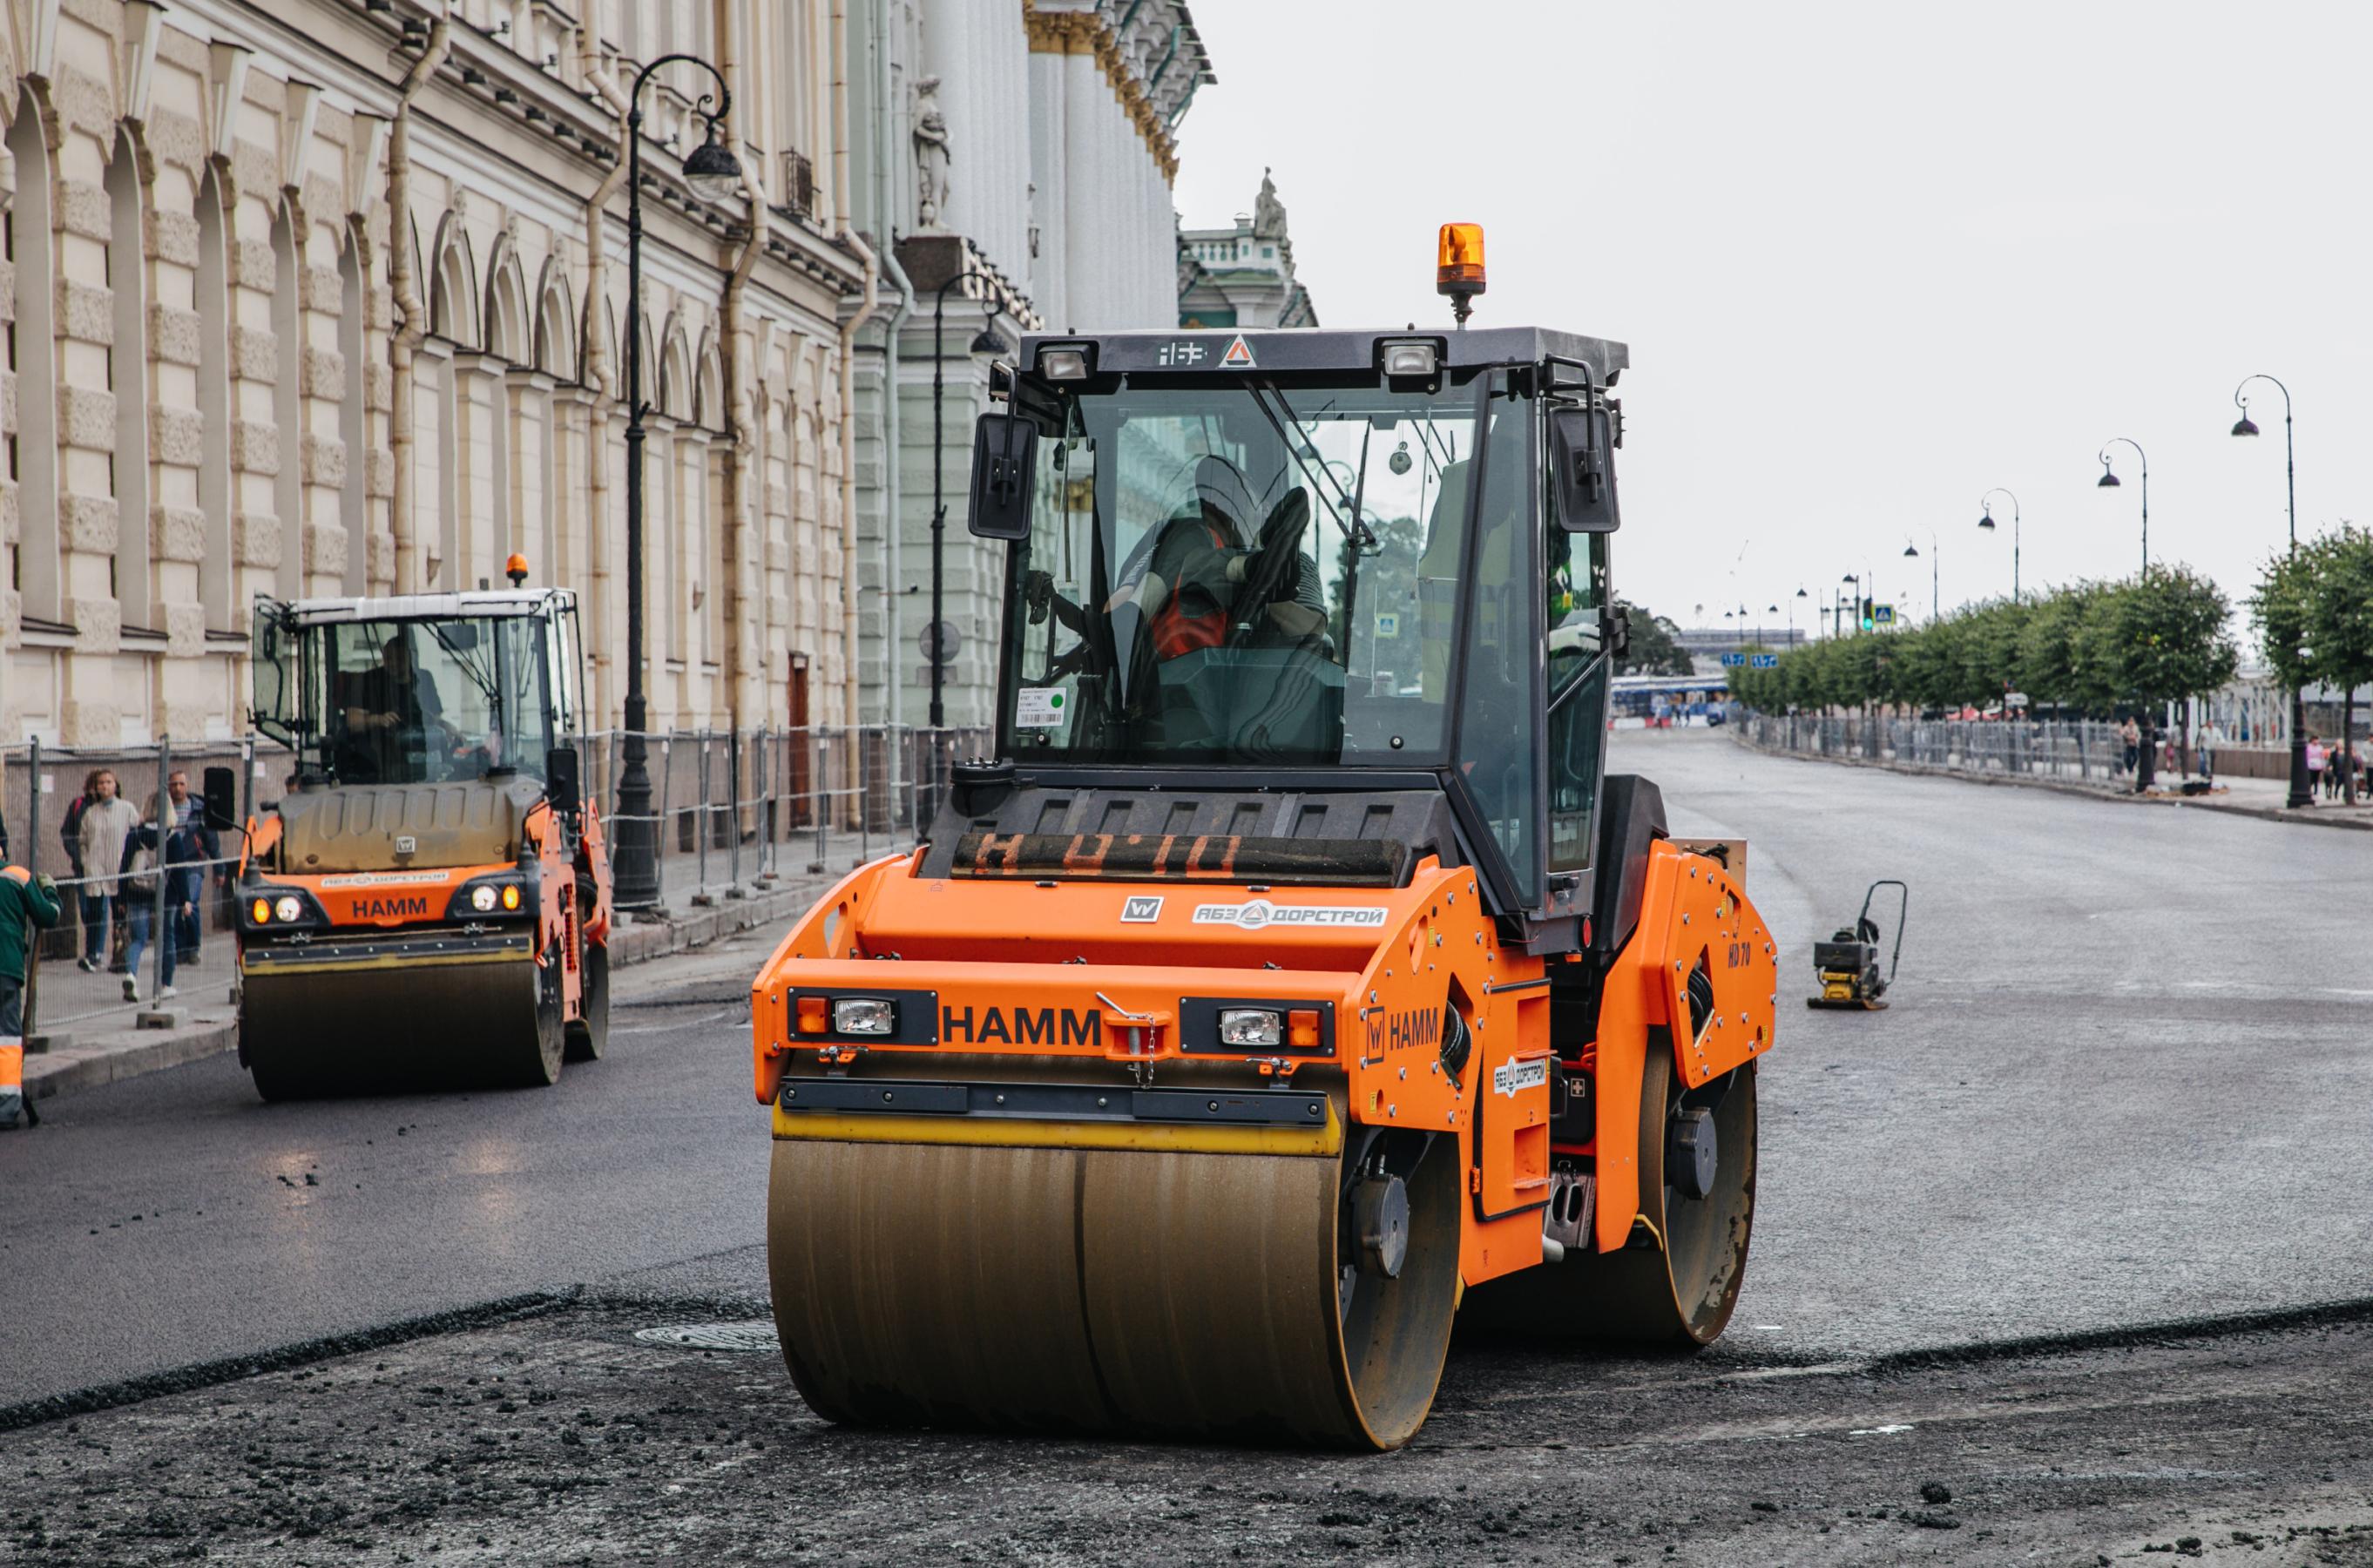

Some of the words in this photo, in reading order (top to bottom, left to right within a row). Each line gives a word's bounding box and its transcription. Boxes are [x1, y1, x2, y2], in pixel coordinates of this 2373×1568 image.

[352, 897, 427, 918] HAMM
[1196, 908, 1238, 920] АБЗ
[1272, 908, 1383, 923] ДОРСТРОЙ
[1728, 943, 1739, 969] HD
[1741, 942, 1750, 967] 70
[943, 1006, 1101, 1046] HAMM
[1390, 1007, 1437, 1051] HAMM
